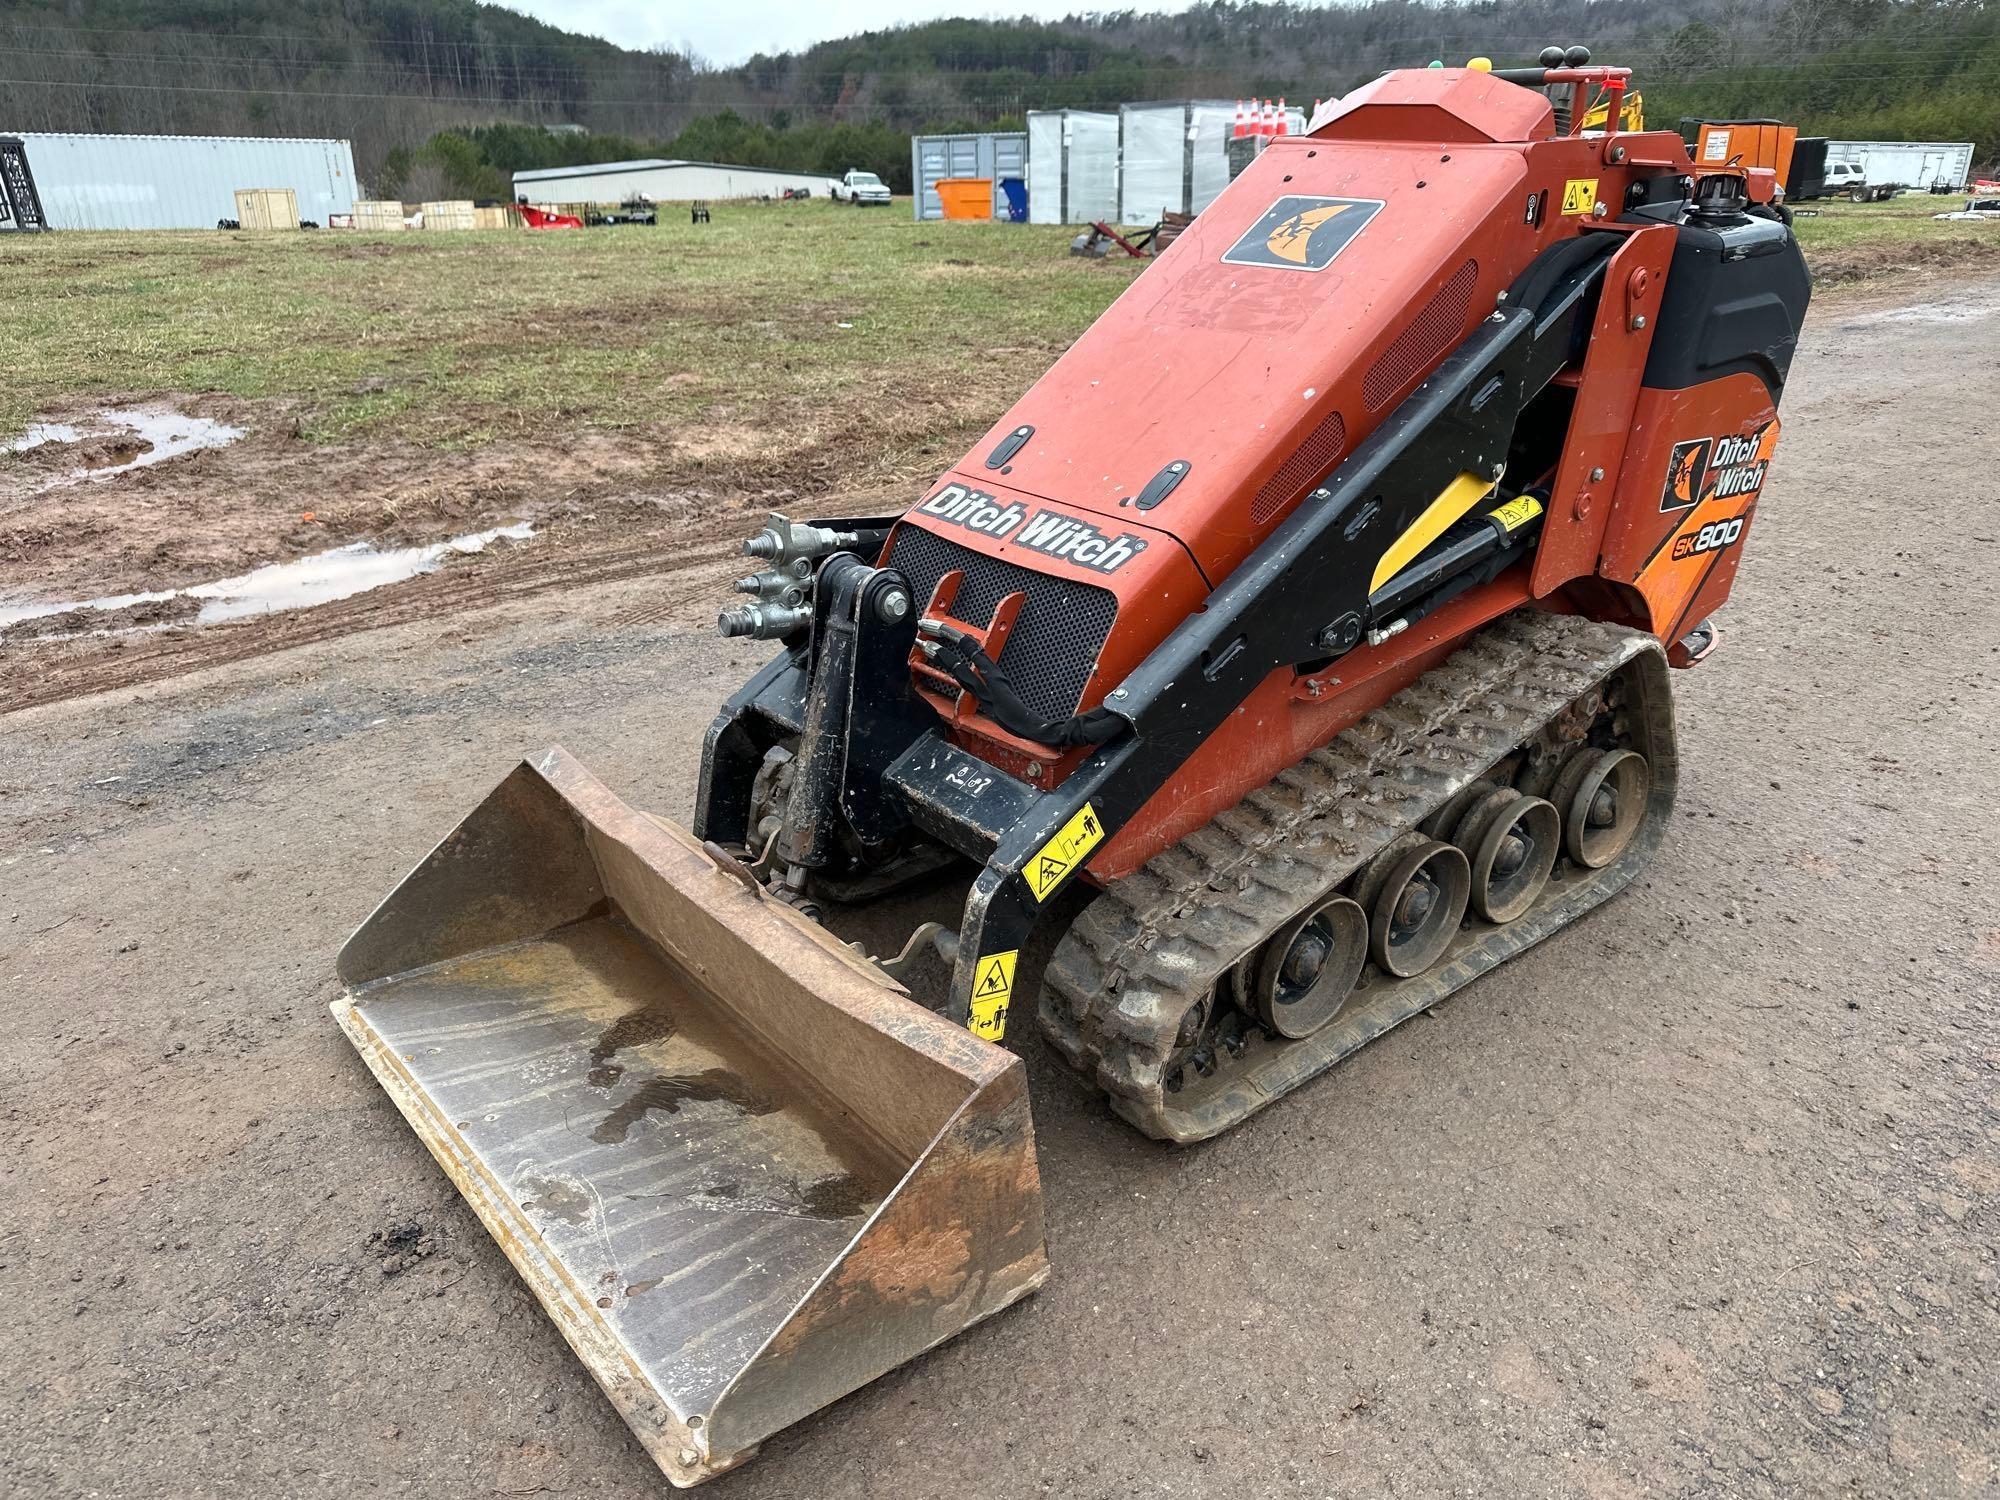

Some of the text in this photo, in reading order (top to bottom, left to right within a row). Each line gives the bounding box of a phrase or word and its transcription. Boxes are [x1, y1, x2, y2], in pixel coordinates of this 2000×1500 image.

[1711, 433, 1760, 468] Ditch
[1715, 462, 1764, 497] Witch
[922, 486, 1133, 570] Ditch Witch
[1673, 518, 1744, 557] SK800
